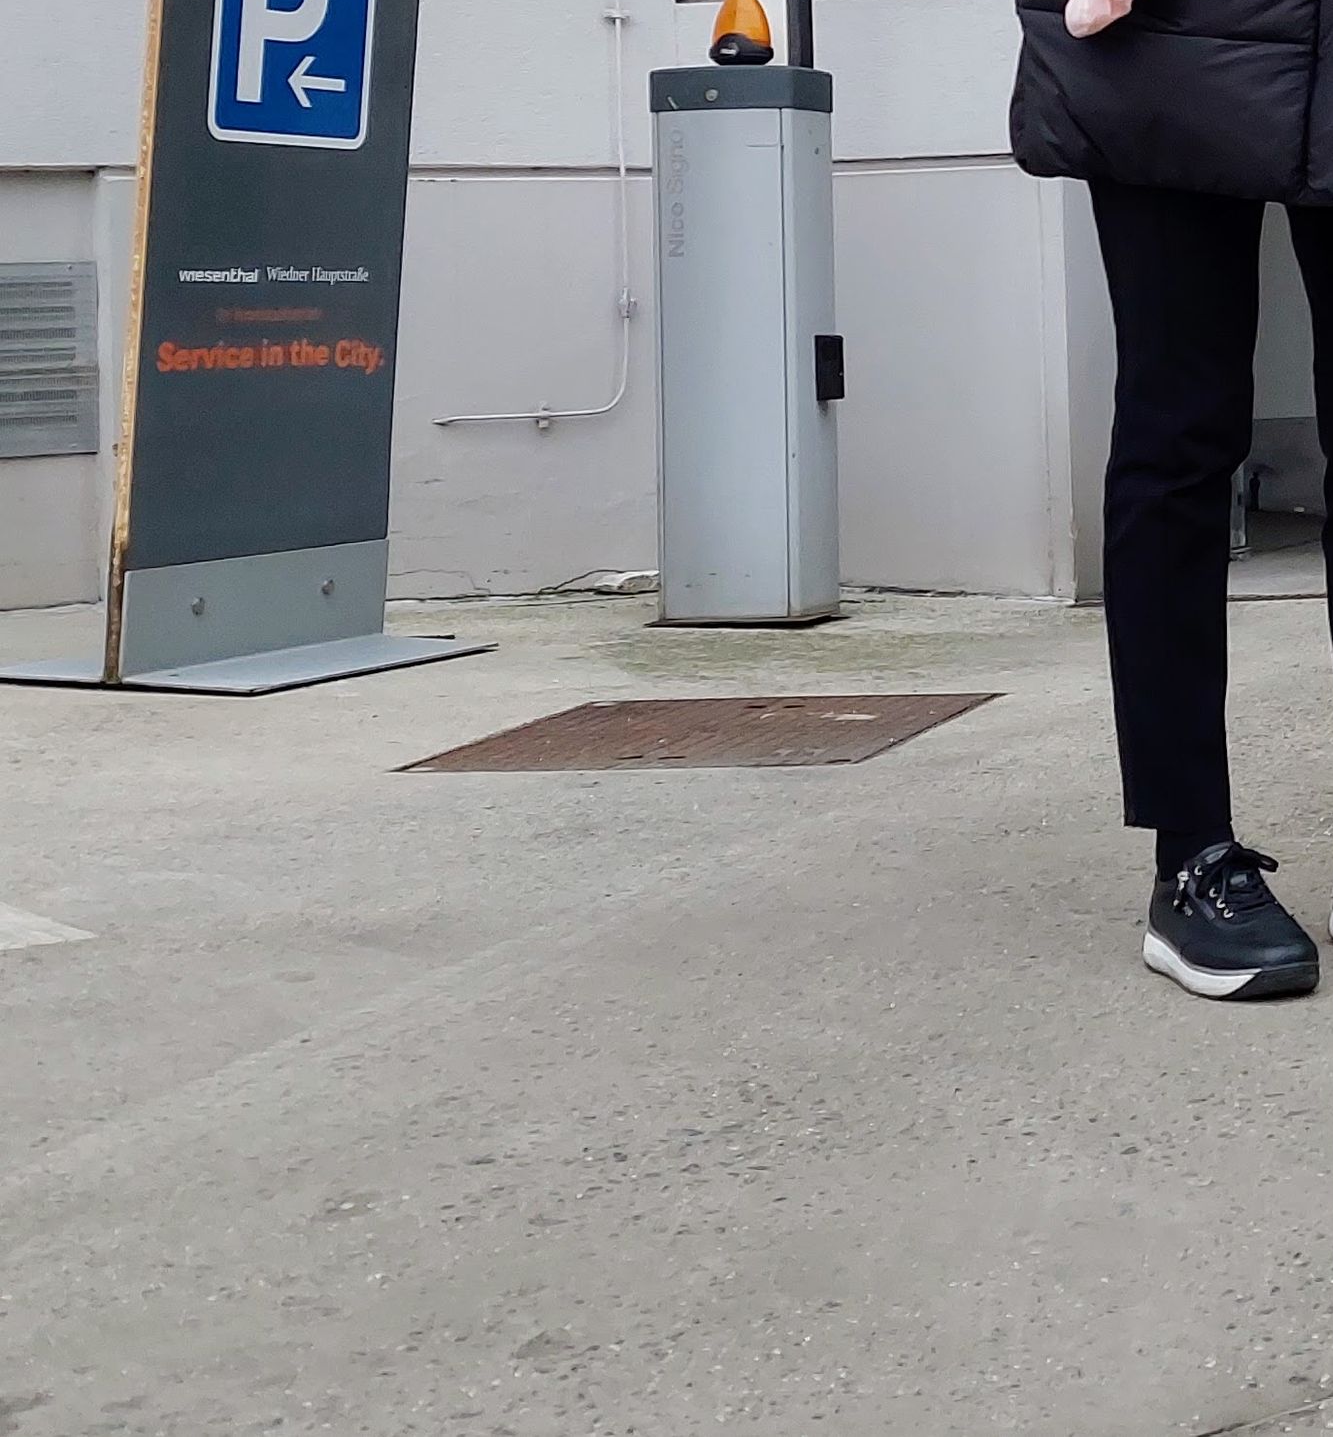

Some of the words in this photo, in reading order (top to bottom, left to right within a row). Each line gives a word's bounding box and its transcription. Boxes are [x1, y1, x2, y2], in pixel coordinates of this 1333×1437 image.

[178, 267, 260, 283] wiesenthal
[266, 265, 310, 282] Wiedner
[311, 265, 370, 286] Hauptstraße
[156, 340, 251, 372] Service
[259, 338, 283, 368] in
[290, 338, 330, 366] the
